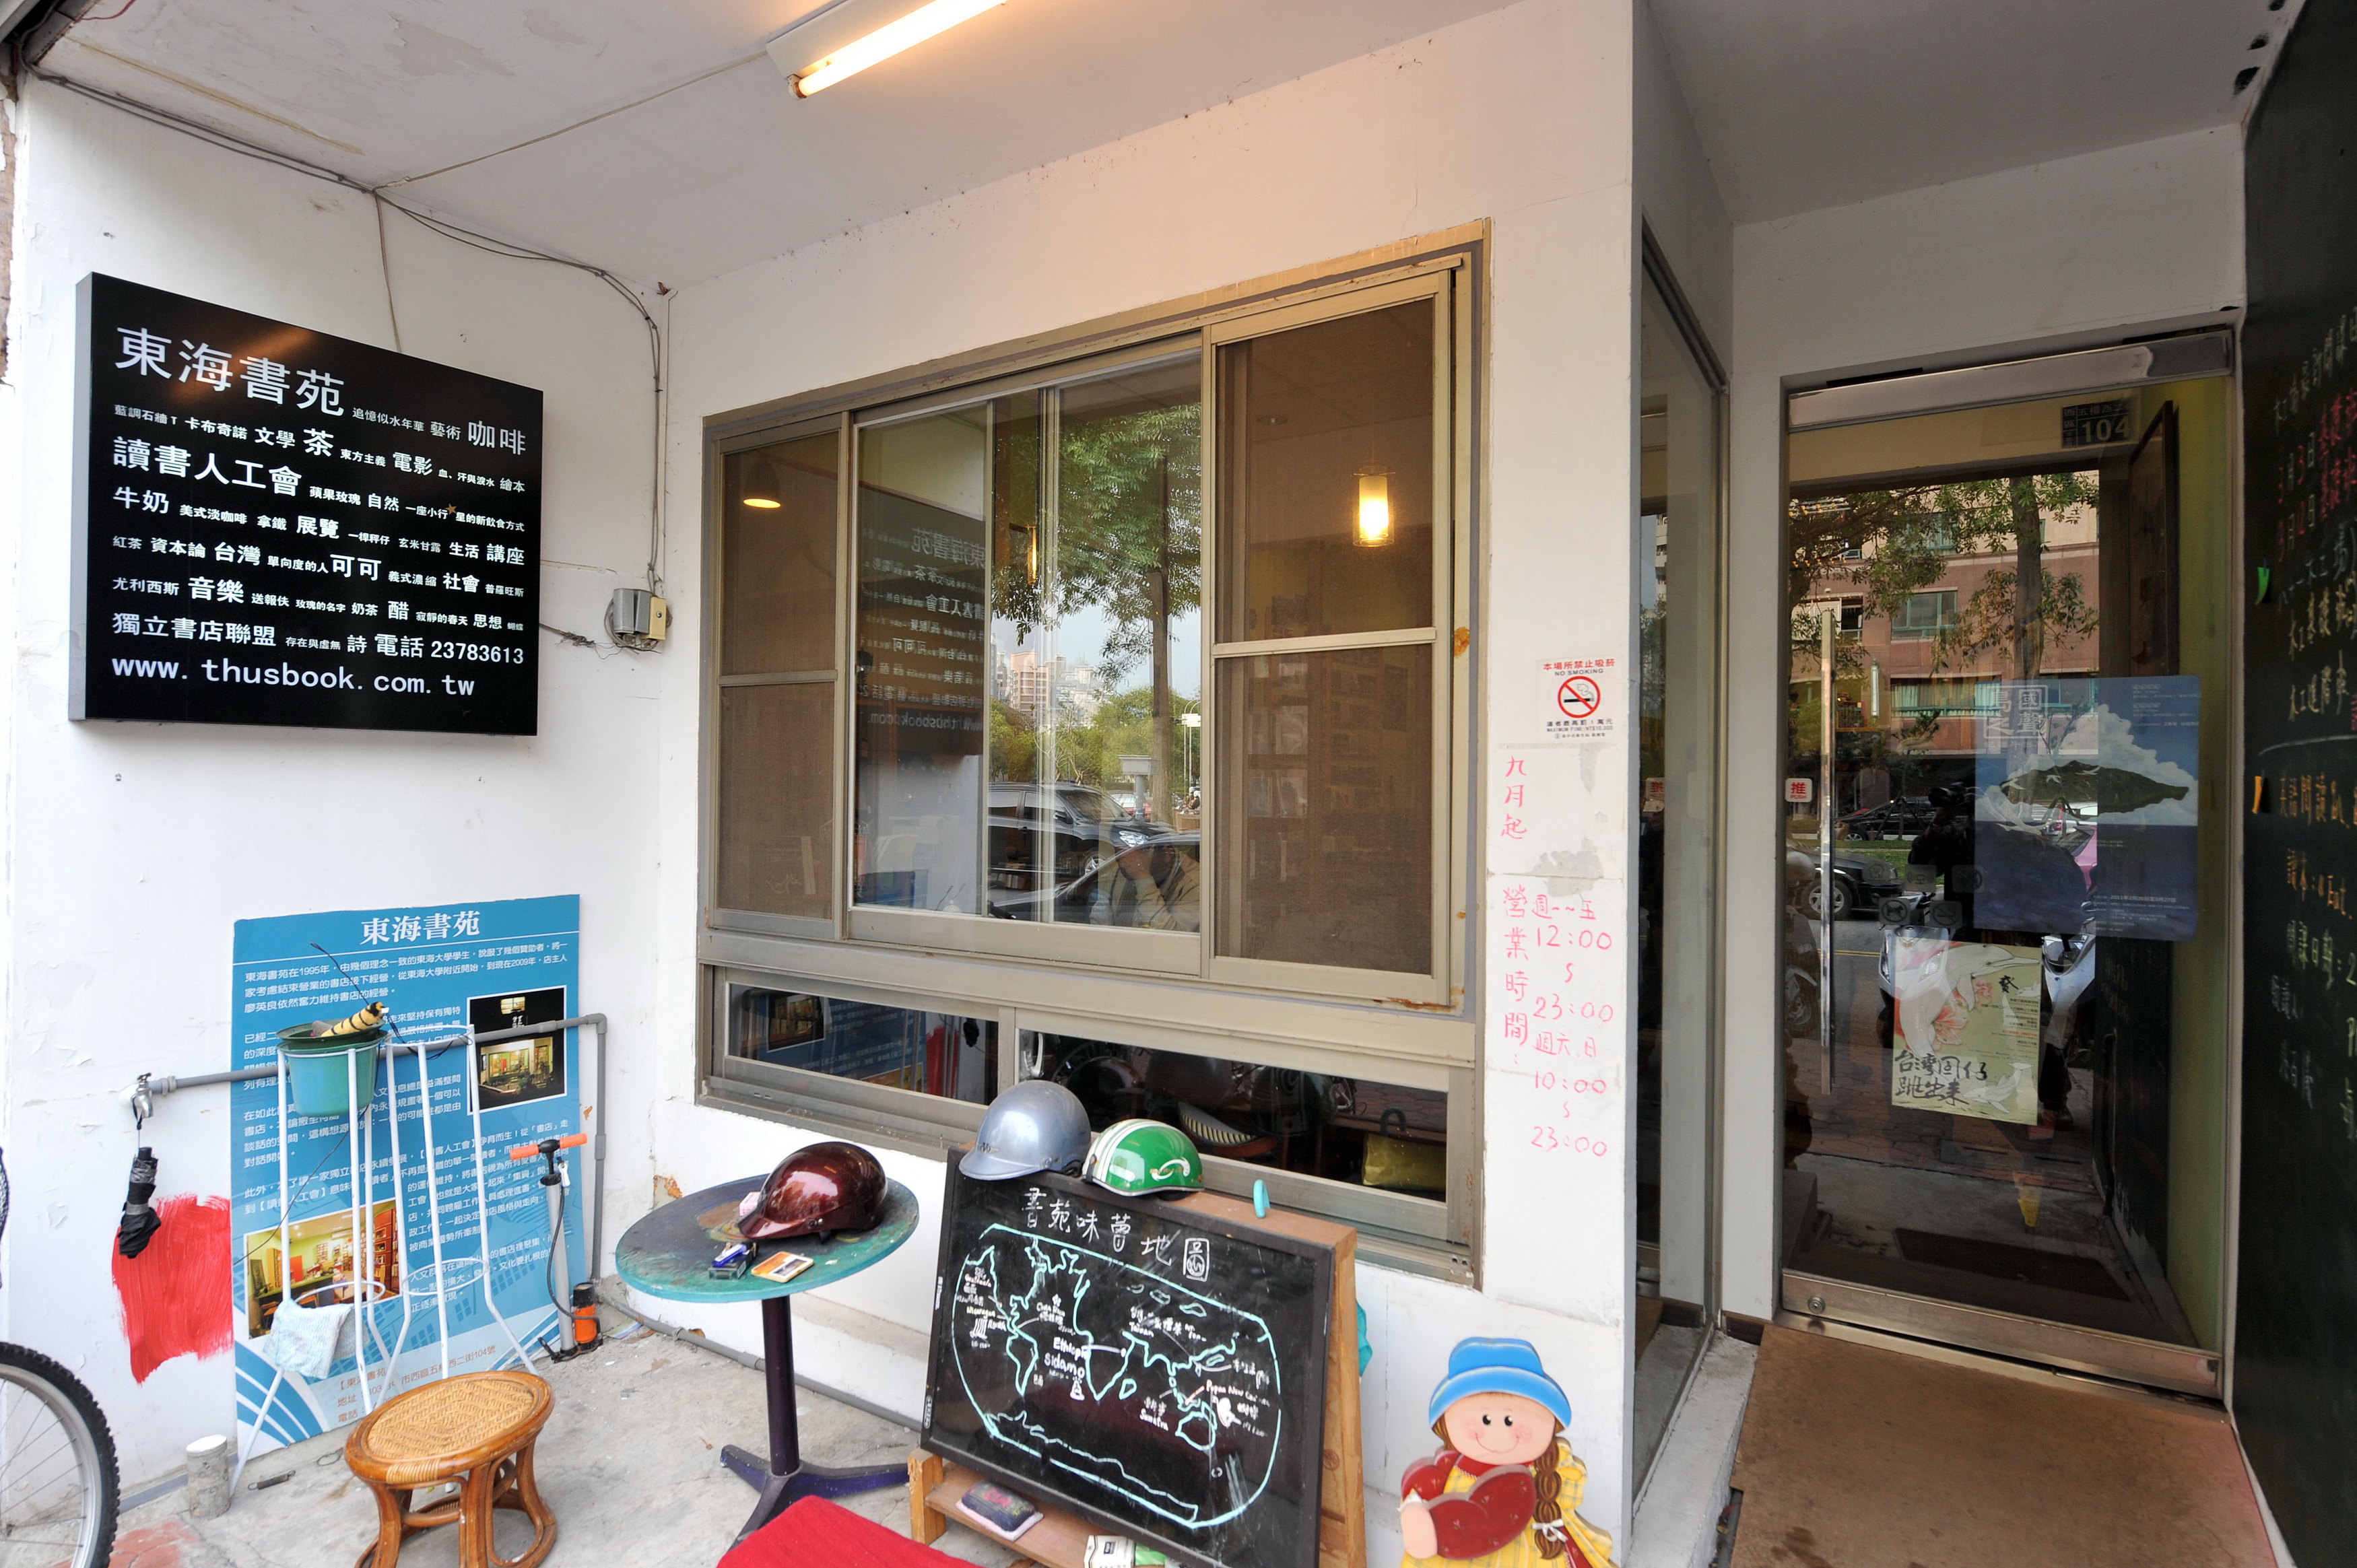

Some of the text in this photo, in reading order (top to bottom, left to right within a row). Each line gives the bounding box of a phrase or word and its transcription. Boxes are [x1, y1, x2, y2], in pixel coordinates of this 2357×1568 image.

[115, 327, 344, 417] 東海書苑
[352, 407, 526, 455] 追憶似水年華 藝術 咖啡
[2081, 415, 2129, 442] 104
[185, 417, 248, 440] 卡布奇諾
[255, 428, 295, 448] 文學
[303, 428, 334, 457] 茶
[340, 448, 386, 467] 東方主義
[393, 452, 432, 476] 電影
[500, 477, 525, 493] 繪本
[113, 436, 302, 497] 讀書人工會
[309, 486, 361, 505] 蘋果玫瑰
[368, 493, 399, 512] 自然
[113, 486, 169, 514] 牛奶
[179, 504, 247, 524] 美式淡咖啡
[257, 514, 287, 531] 拿鐵
[296, 515, 339, 539] 展覽
[449, 542, 479, 559] 生活
[486, 543, 525, 566] 講座
[112, 536, 524, 598] 紅茶 資本論 台灣 單向度的人 可可 義式濃縮 社會 普羅旺斯
[112, 577, 180, 596] 尤利西斯
[188, 576, 244, 603] 音樂
[296, 599, 346, 613] 玫瑰的名字
[351, 603, 378, 616] 奶茶
[388, 601, 409, 621] 醋
[416, 611, 468, 626] 寂靜的春天
[473, 613, 502, 629] 思想
[112, 612, 524, 664] 獨立書店聯盟 存在與虛無 詩 電話 23783613
[1543, 658, 1616, 671] 本場所禁止吸菸
[1568, 668, 1603, 676] SMOKING
[1791, 782, 1807, 794] 推
[360, 910, 480, 945] 東海書苑
[1537, 924, 1612, 950] 12:00
[1533, 993, 1614, 1023] 23:00
[1535, 1070, 1607, 1094] 10:00
[1531, 1126, 1607, 1157] 23:00
[1044, 1353, 1085, 1379] Sidamo
